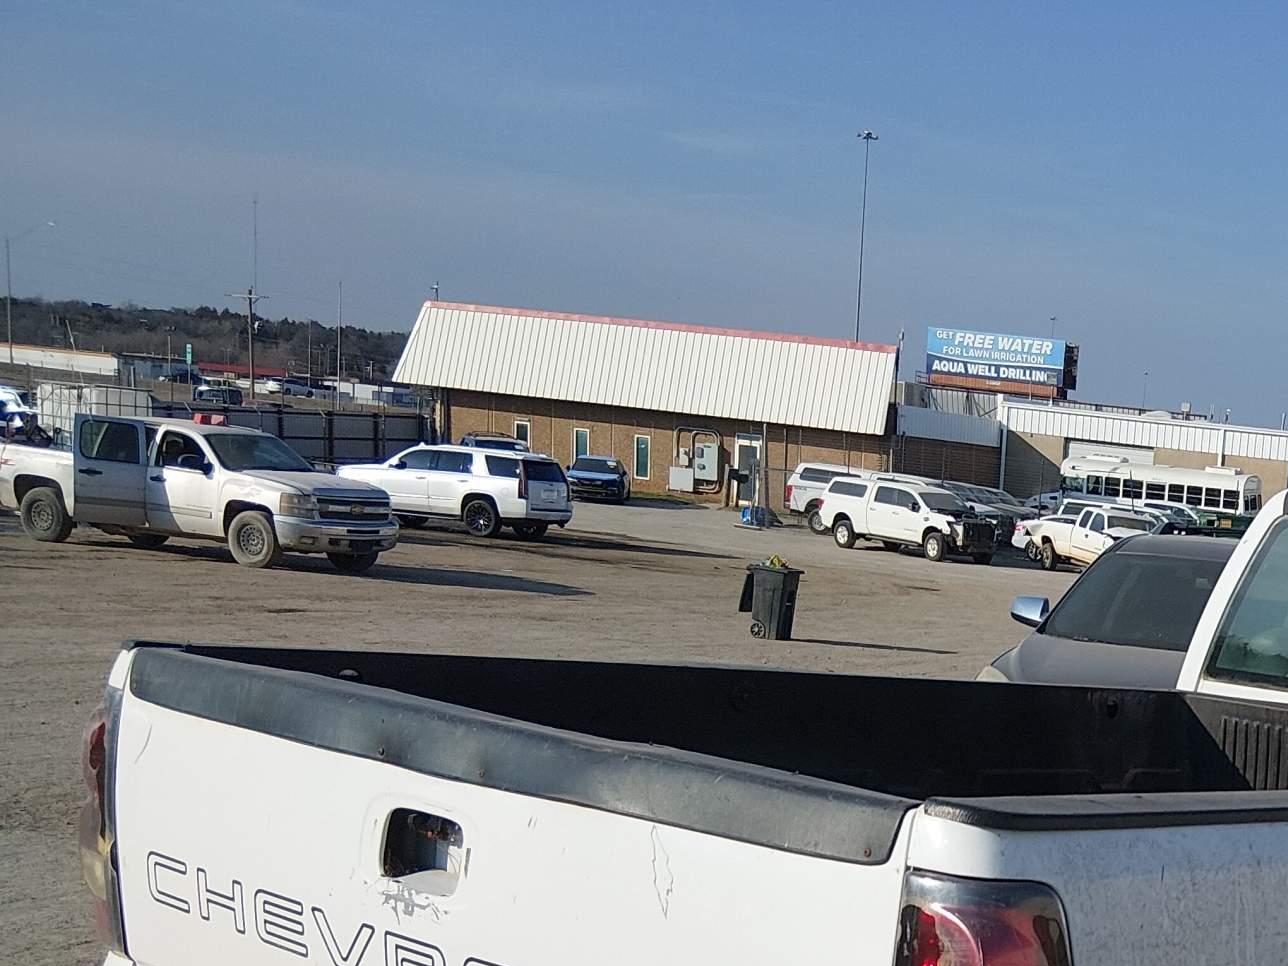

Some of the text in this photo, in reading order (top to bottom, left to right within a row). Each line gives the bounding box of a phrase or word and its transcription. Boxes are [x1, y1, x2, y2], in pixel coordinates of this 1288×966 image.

[936, 330, 1053, 354] GET FREE WATER
[943, 346, 1044, 364] FOR LAWN IRRIGATION
[932, 360, 965, 373] AQUA
[967, 363, 997, 377] WELL
